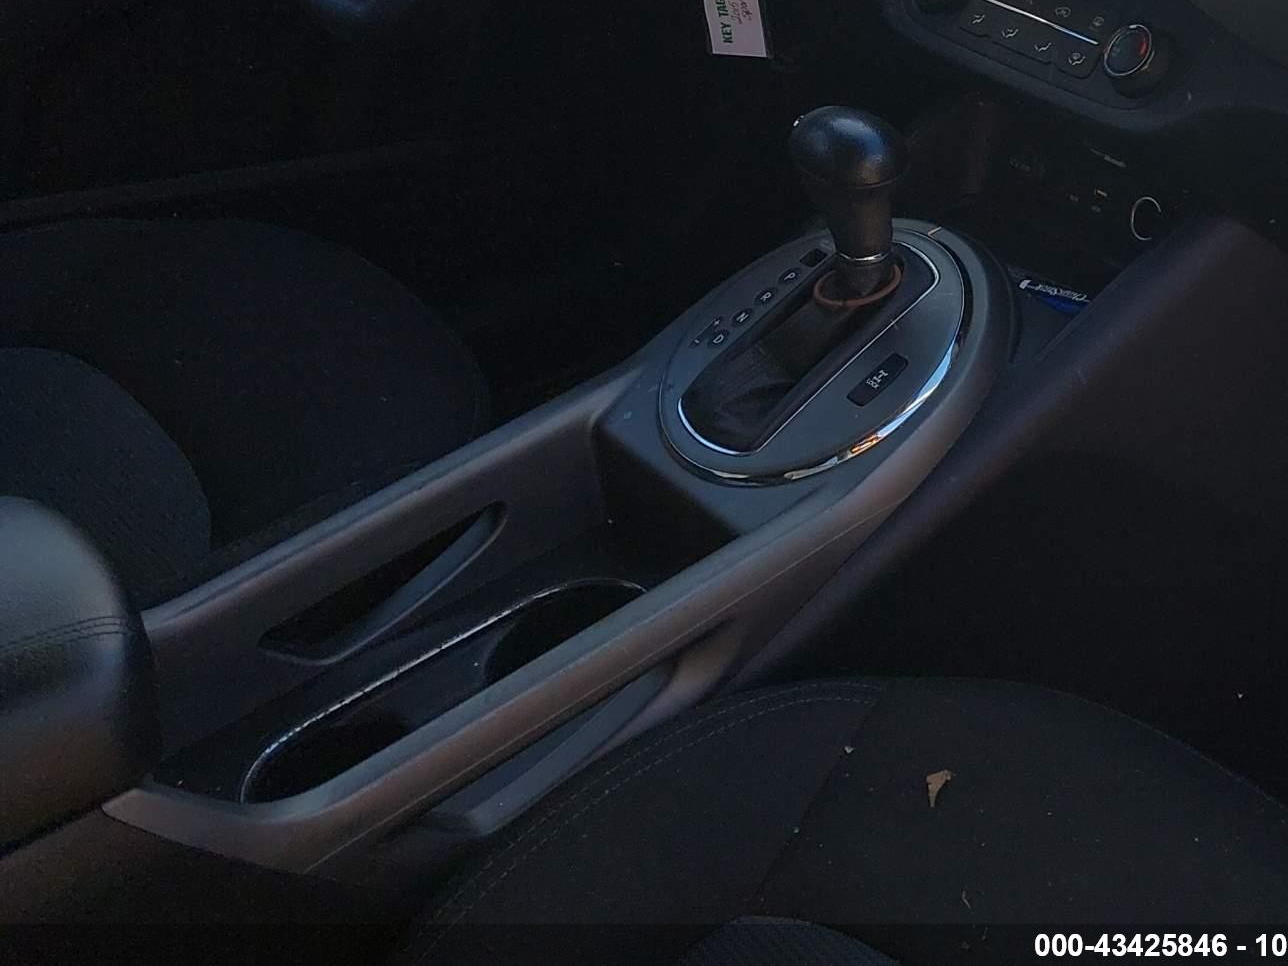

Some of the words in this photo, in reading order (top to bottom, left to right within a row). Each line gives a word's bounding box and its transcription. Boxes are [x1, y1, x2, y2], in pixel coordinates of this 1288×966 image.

[720, 22, 733, 44] KEY
[783, 271, 796, 281] P
[760, 291, 772, 302] R
[736, 312, 749, 323] N
[712, 333, 724, 344] D
